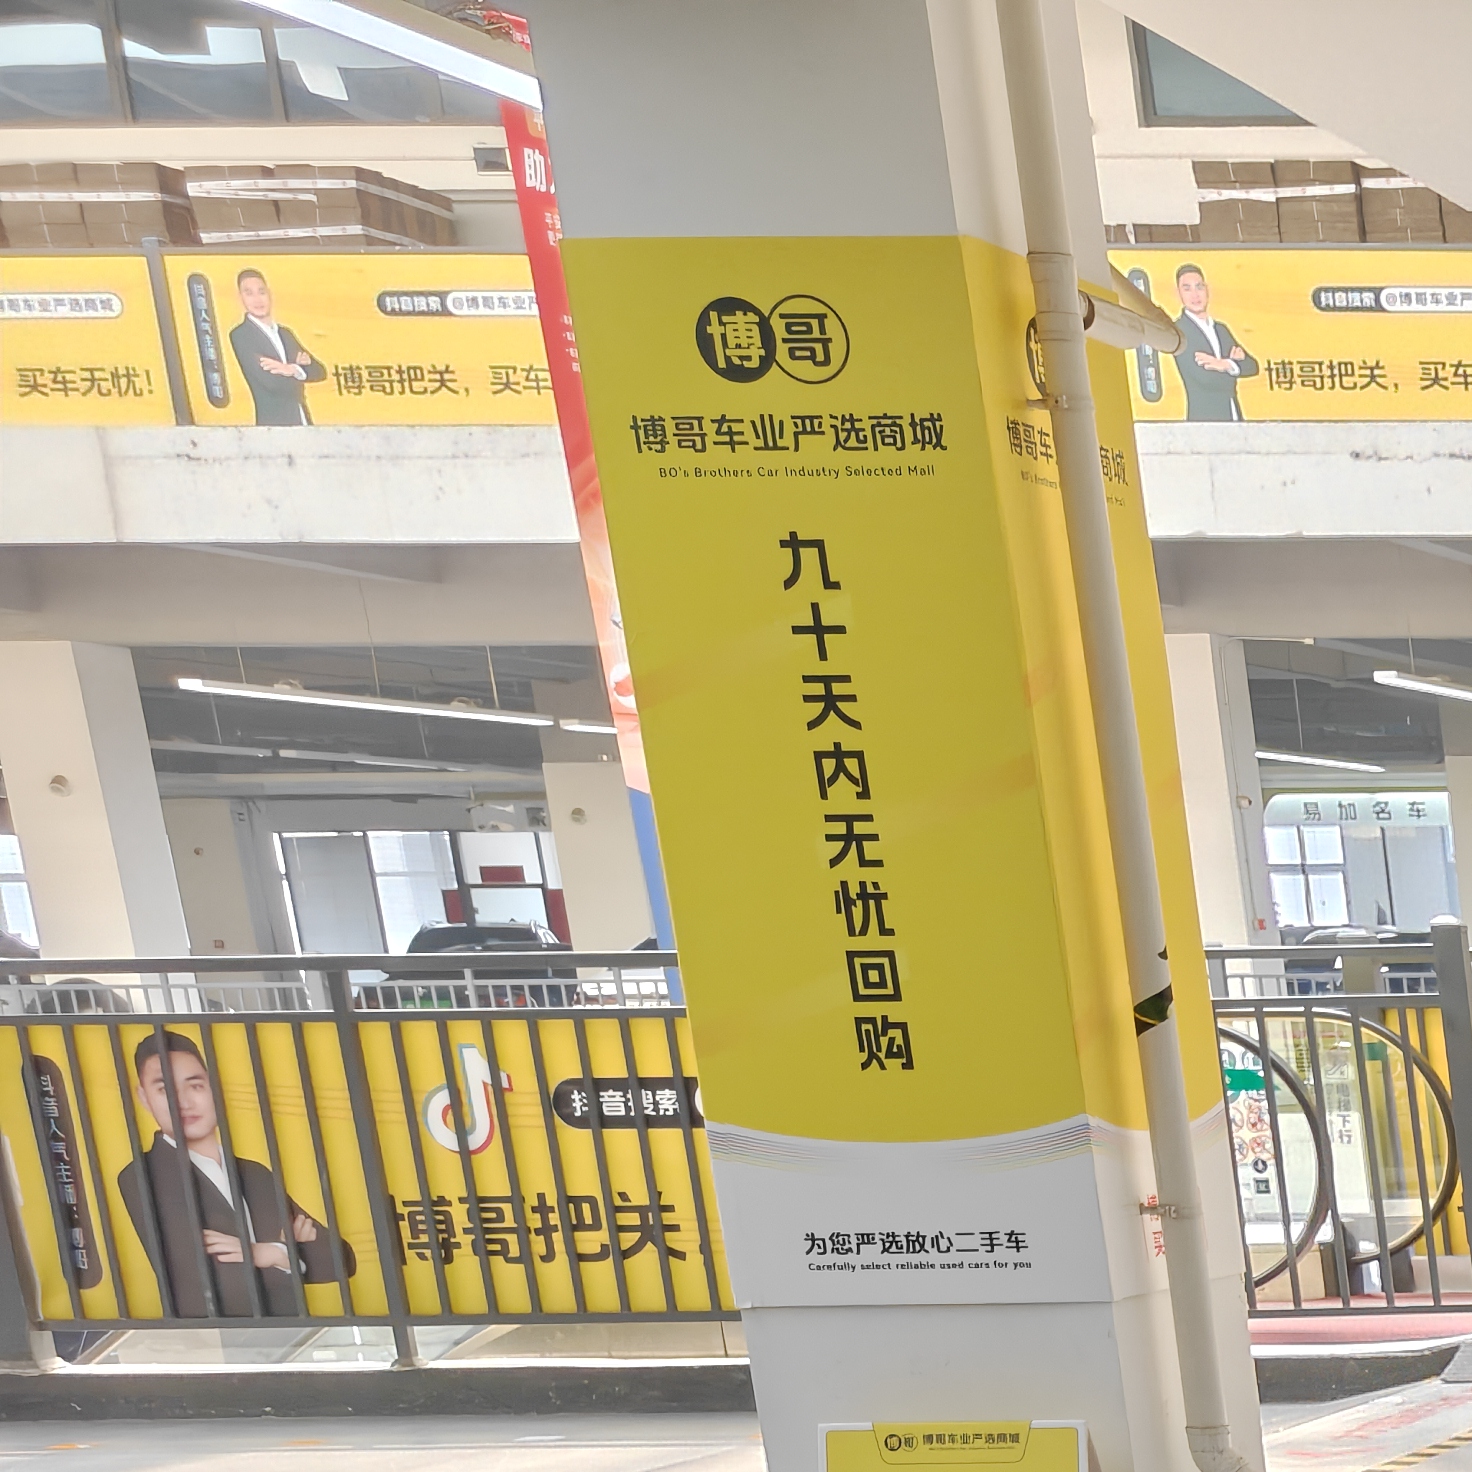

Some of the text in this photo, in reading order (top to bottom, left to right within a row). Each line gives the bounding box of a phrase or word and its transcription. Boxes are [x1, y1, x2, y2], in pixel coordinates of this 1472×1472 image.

[704, 308, 838, 373] 博哥
[630, 413, 947, 454] 博哥车业严选商城
[694, 466, 752, 478] Brothers
[757, 466, 780, 478] Car
[785, 464, 840, 480] Industry
[845, 464, 903, 477] Selected
[907, 463, 936, 477] Mall
[779, 531, 914, 1071] 九十天内无忧回购
[1302, 800, 1428, 821] 易加名车
[803, 1230, 1030, 1256] 为您严选放心二手车
[808, 1262, 857, 1273] Carefully
[895, 1260, 936, 1270] reliable
[939, 1259, 964, 1270] used
[968, 1261, 990, 1269] cars
[993, 1260, 1009, 1269] for
[1012, 1260, 1032, 1271] you
